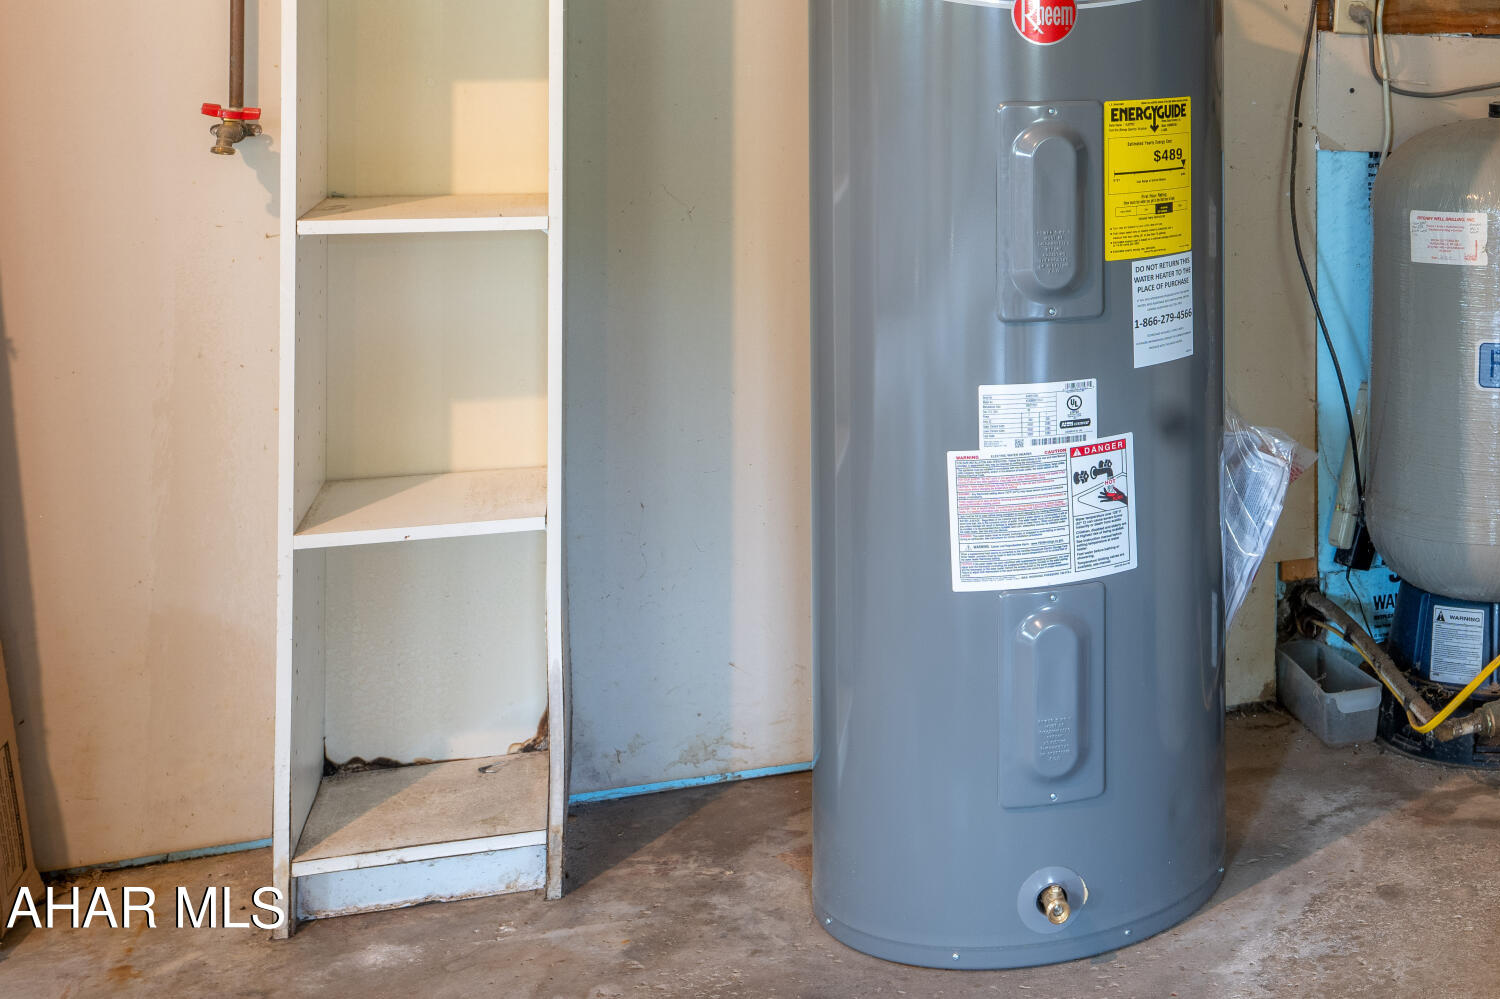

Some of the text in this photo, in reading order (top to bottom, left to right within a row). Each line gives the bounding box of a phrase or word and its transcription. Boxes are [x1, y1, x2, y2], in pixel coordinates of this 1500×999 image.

[1111, 104, 1186, 124] ENERGYGUIDE
[1154, 148, 1183, 162] $489
[1159, 260, 1179, 269] RETURN
[1180, 257, 1190, 265] THIS
[1134, 274, 1154, 283] WATER
[1156, 271, 1174, 280] HEATER
[1183, 267, 1191, 275] THE
[1137, 277, 1189, 293] PLACE OF PURCHASE
[1135, 308, 1192, 328] 1-866-279-4566
[1084, 441, 1123, 454] DANGER
[1449, 614, 1480, 622] WARNING
